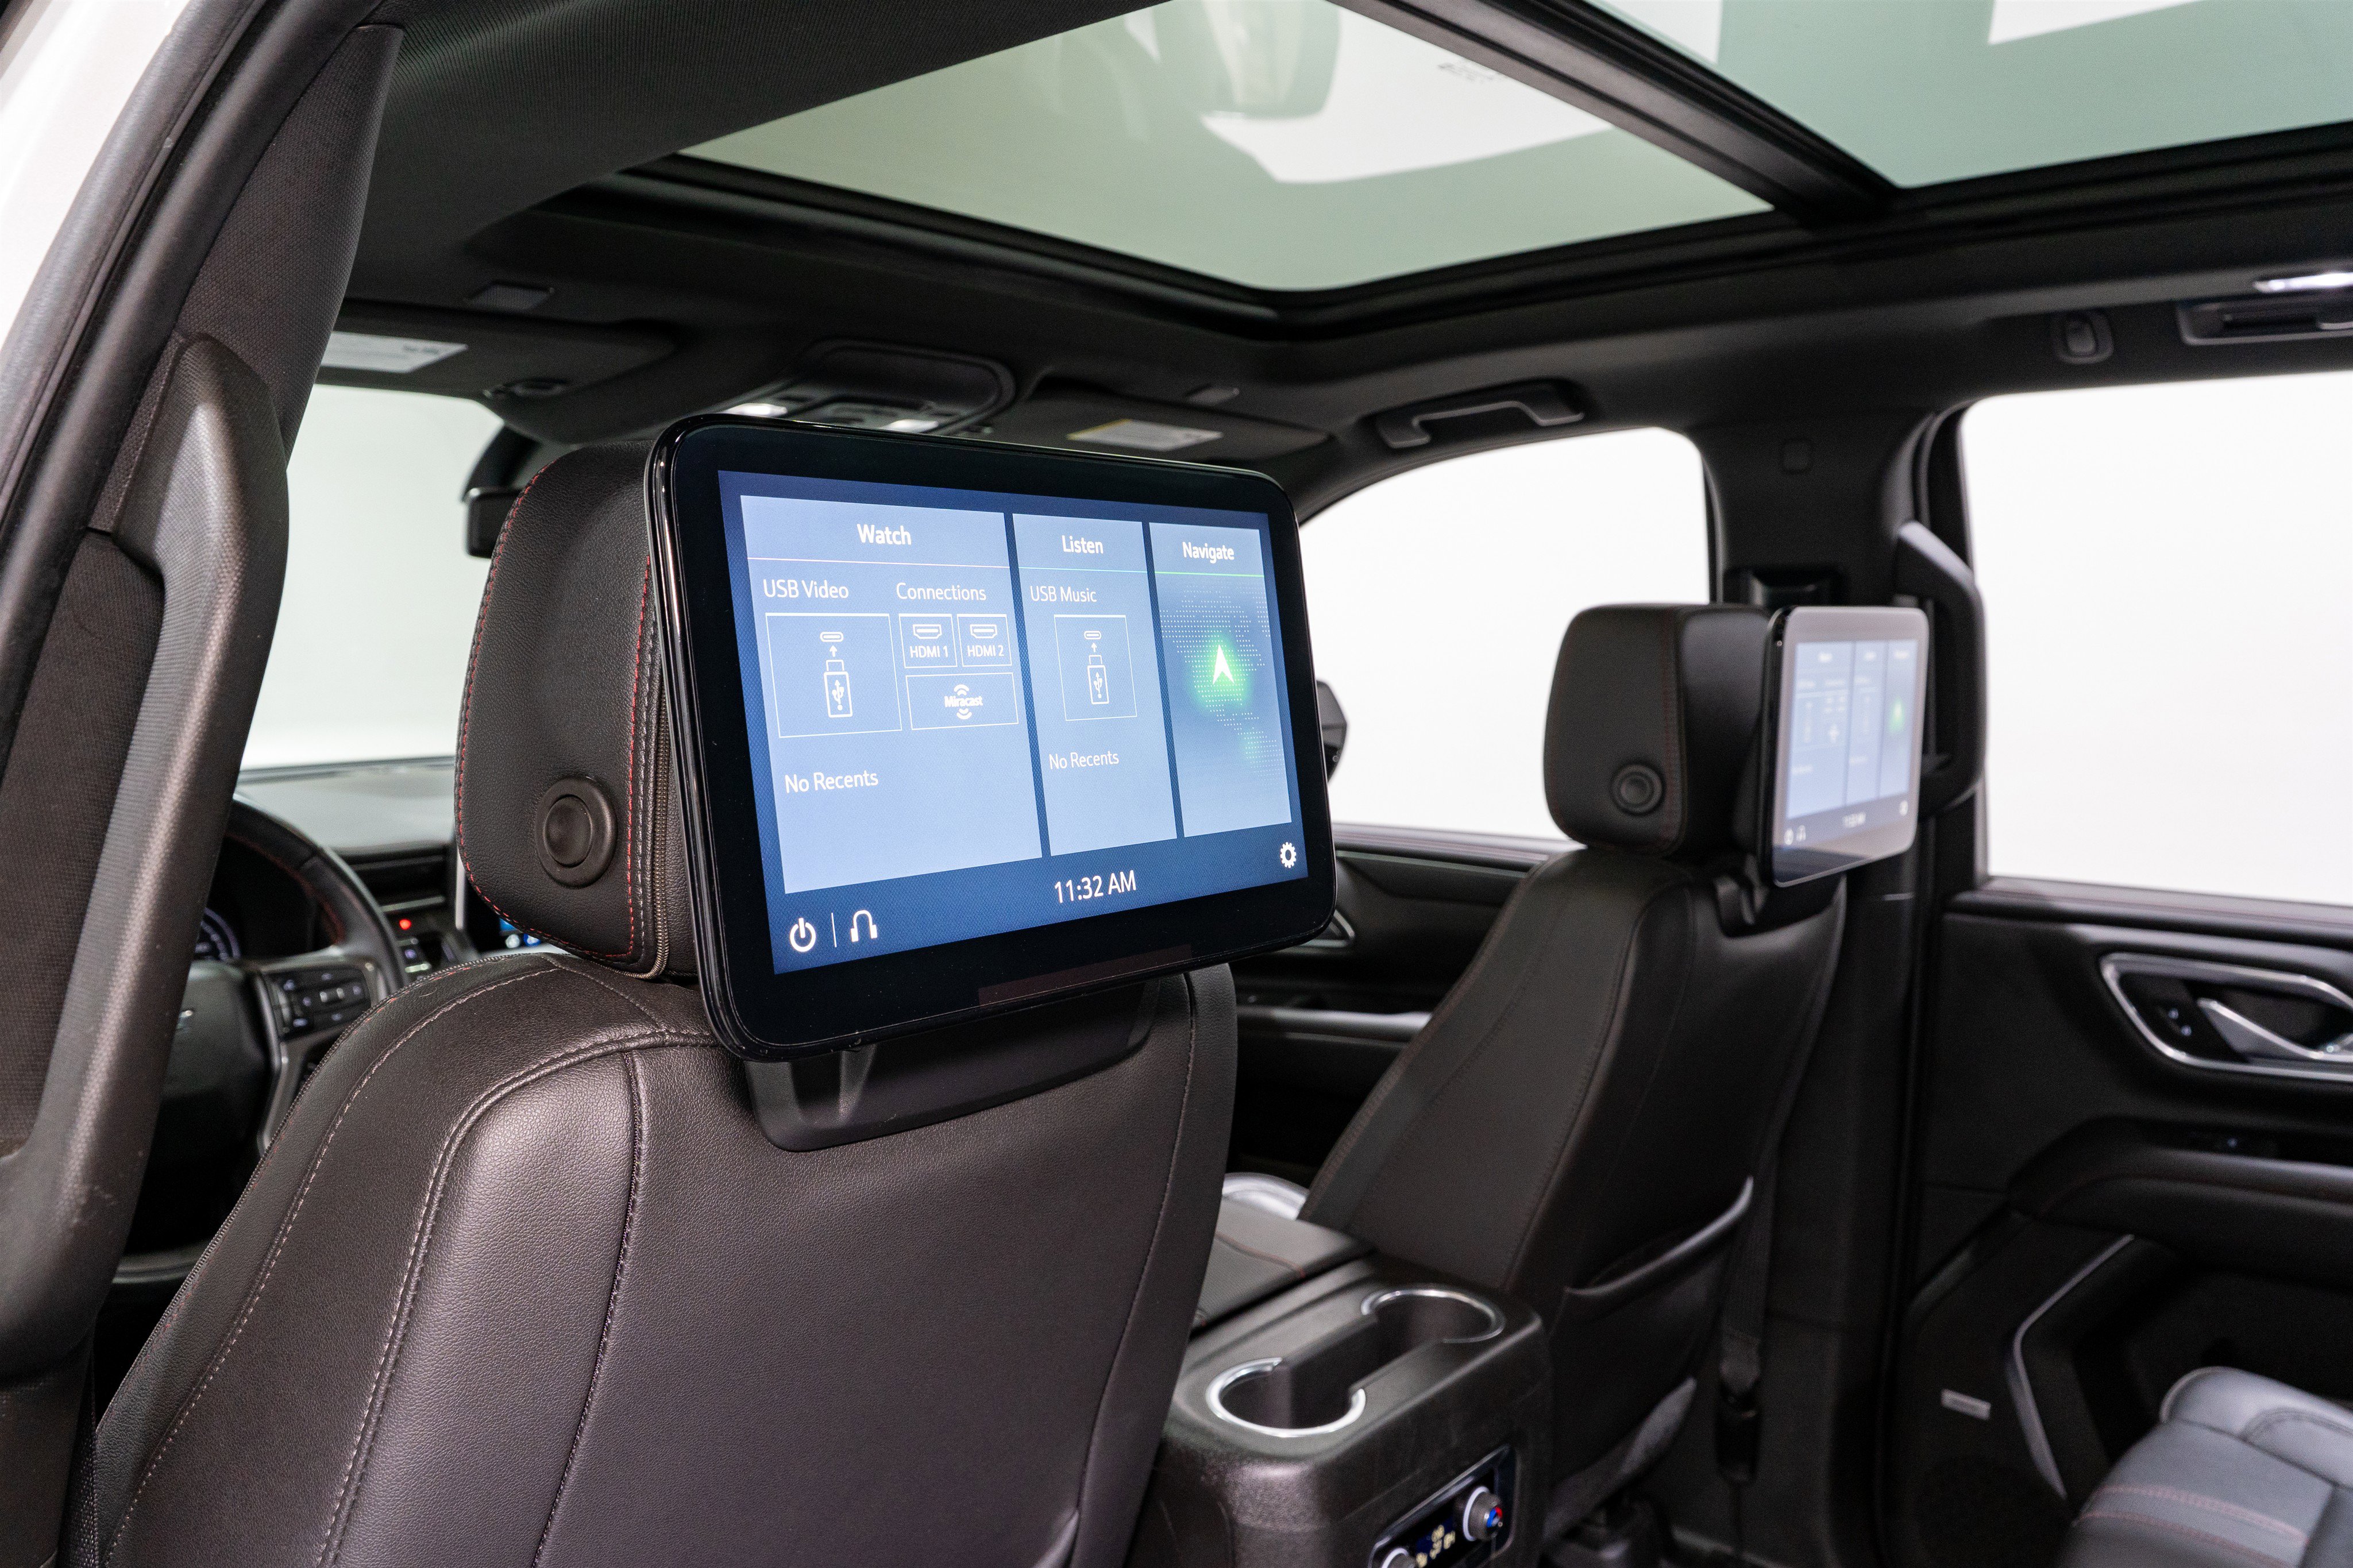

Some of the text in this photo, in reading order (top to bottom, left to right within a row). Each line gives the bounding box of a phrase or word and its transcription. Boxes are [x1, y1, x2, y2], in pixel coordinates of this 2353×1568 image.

[857, 523, 912, 545] Watch
[1062, 535, 1104, 554] Listen
[1182, 542, 1234, 563] Navigate
[763, 579, 849, 598] USB Video
[896, 582, 986, 601] Connections
[1030, 586, 1097, 603] USB Music
[909, 644, 948, 658] HDMI 1
[966, 644, 1004, 658] HDMI 2
[944, 695, 983, 708] Miracast
[1048, 750, 1120, 770] No Recents
[785, 769, 879, 794] No Recents
[1054, 870, 1137, 903] 11:32 AM
